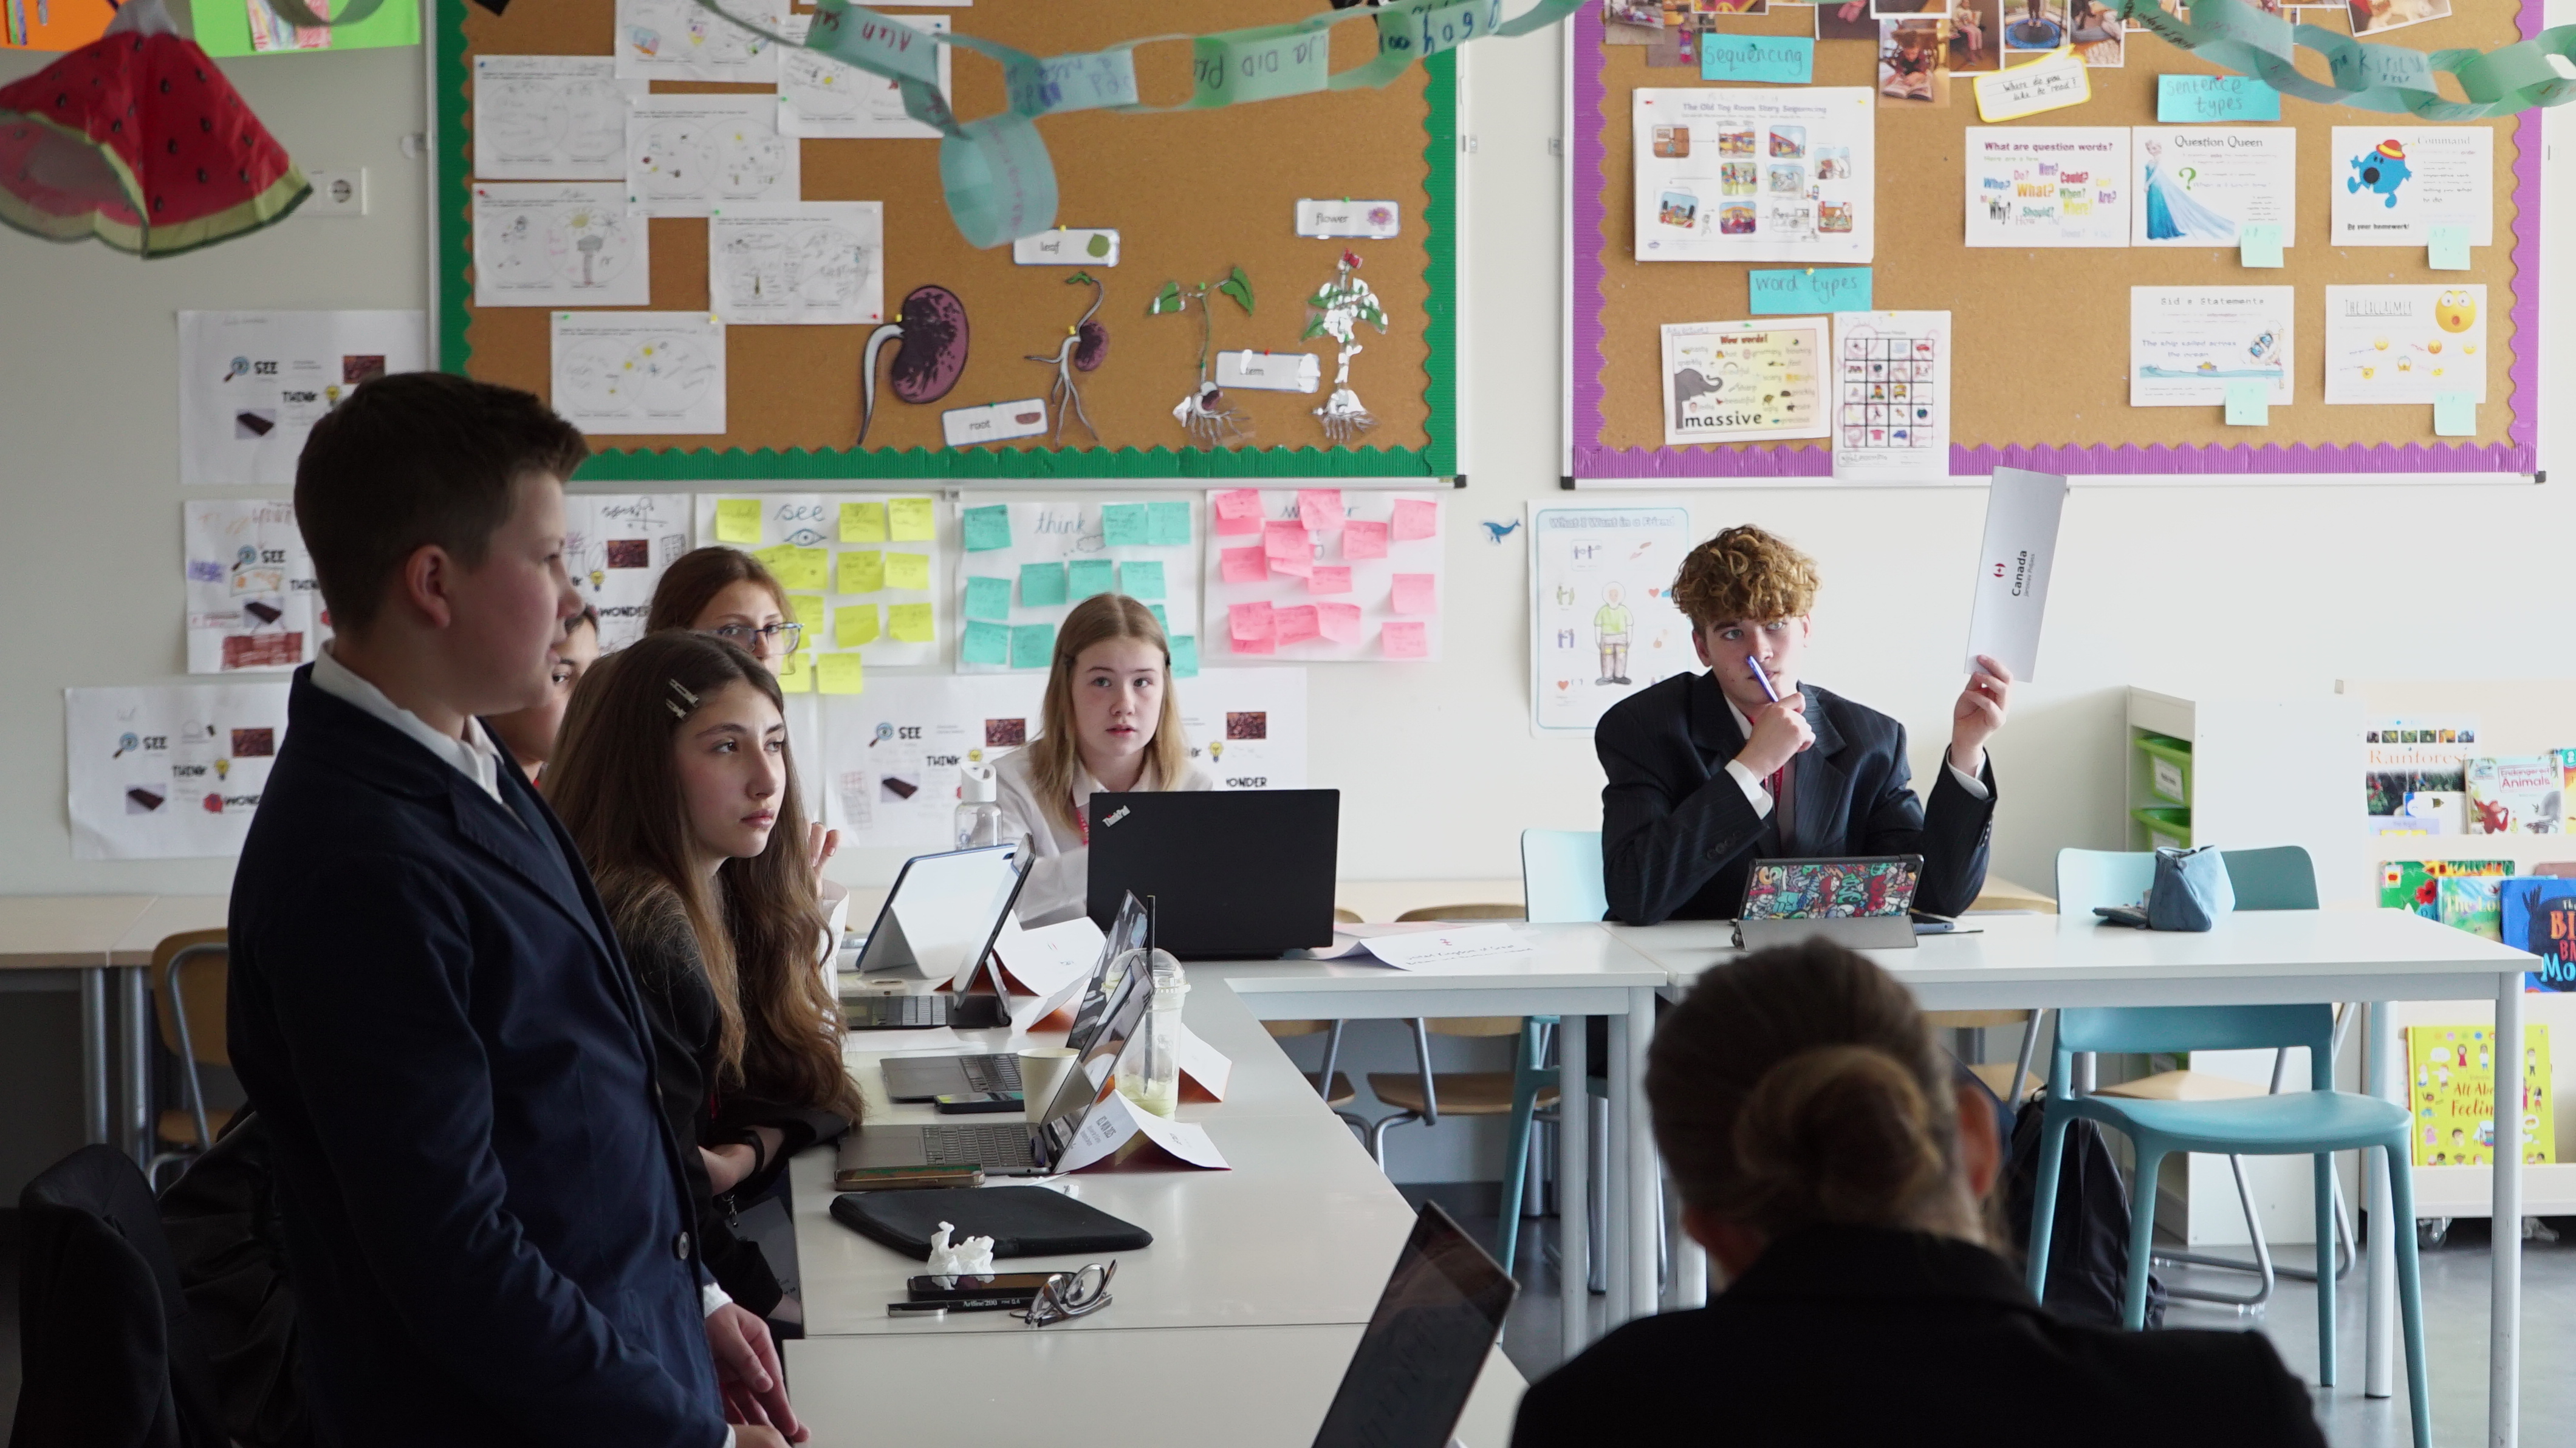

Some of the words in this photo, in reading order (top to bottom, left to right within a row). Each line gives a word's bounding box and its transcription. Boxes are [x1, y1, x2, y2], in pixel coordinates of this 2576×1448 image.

[1704, 44, 1804, 76] Sequencing
[2166, 78, 2244, 97] sentence
[2193, 95, 2244, 118] types
[1984, 142, 2010, 151] What
[2013, 143, 2030, 151] are
[2032, 142, 2075, 154] question
[2078, 142, 2114, 152] words?
[2174, 134, 2224, 148] Question
[2227, 135, 2263, 148] Queen
[2417, 136, 2471, 145] Command
[2016, 183, 2055, 198] What?
[1315, 211, 1349, 225] flower
[1989, 200, 2012, 226] Why?
[1040, 239, 1060, 254] leaf
[1755, 275, 1799, 292] word
[1810, 275, 1858, 304] types
[969, 418, 992, 430] root
[1685, 410, 1762, 428] massive
[773, 503, 826, 522] see
[1035, 511, 1087, 535] think
[2012, 550, 2027, 596] Canada
[898, 726, 922, 739] SEE
[926, 756, 961, 767] THINK
[2501, 777, 2552, 788] Animals
[1101, 804, 1131, 828] ThinkPad
[2447, 895, 2471, 912] The
[2454, 1082, 2471, 1097] All
